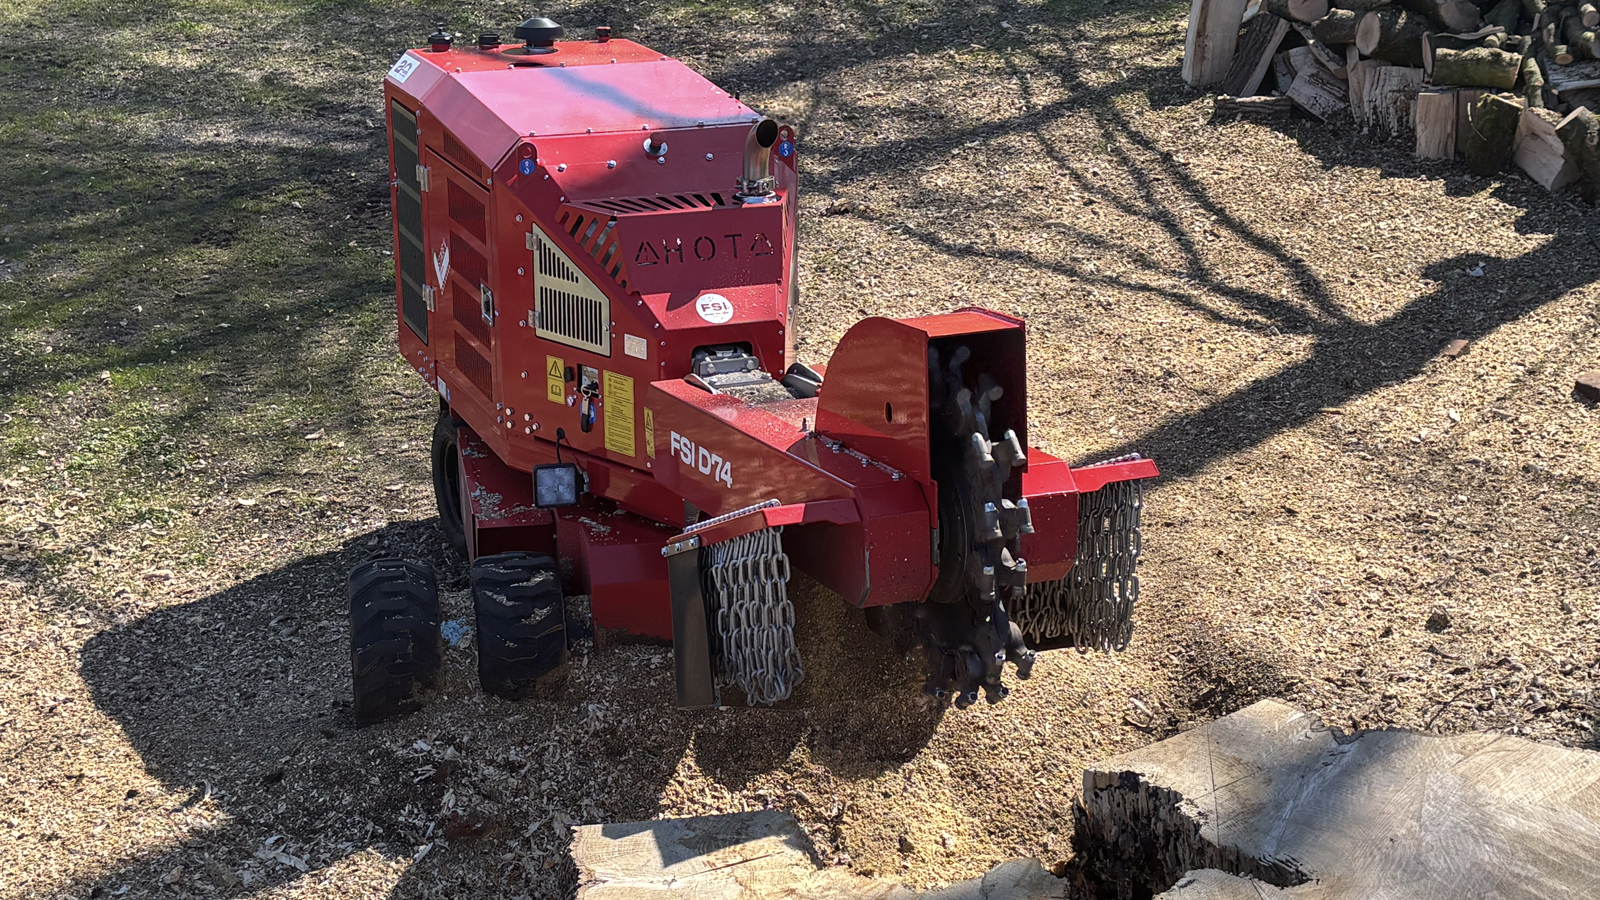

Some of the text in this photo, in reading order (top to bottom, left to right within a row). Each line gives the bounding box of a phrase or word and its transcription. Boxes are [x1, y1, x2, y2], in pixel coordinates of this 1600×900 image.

[662, 234, 742, 264] HOT
[700, 302, 728, 312] FSI
[670, 430, 696, 468] FSI
[698, 445, 733, 489] D74
